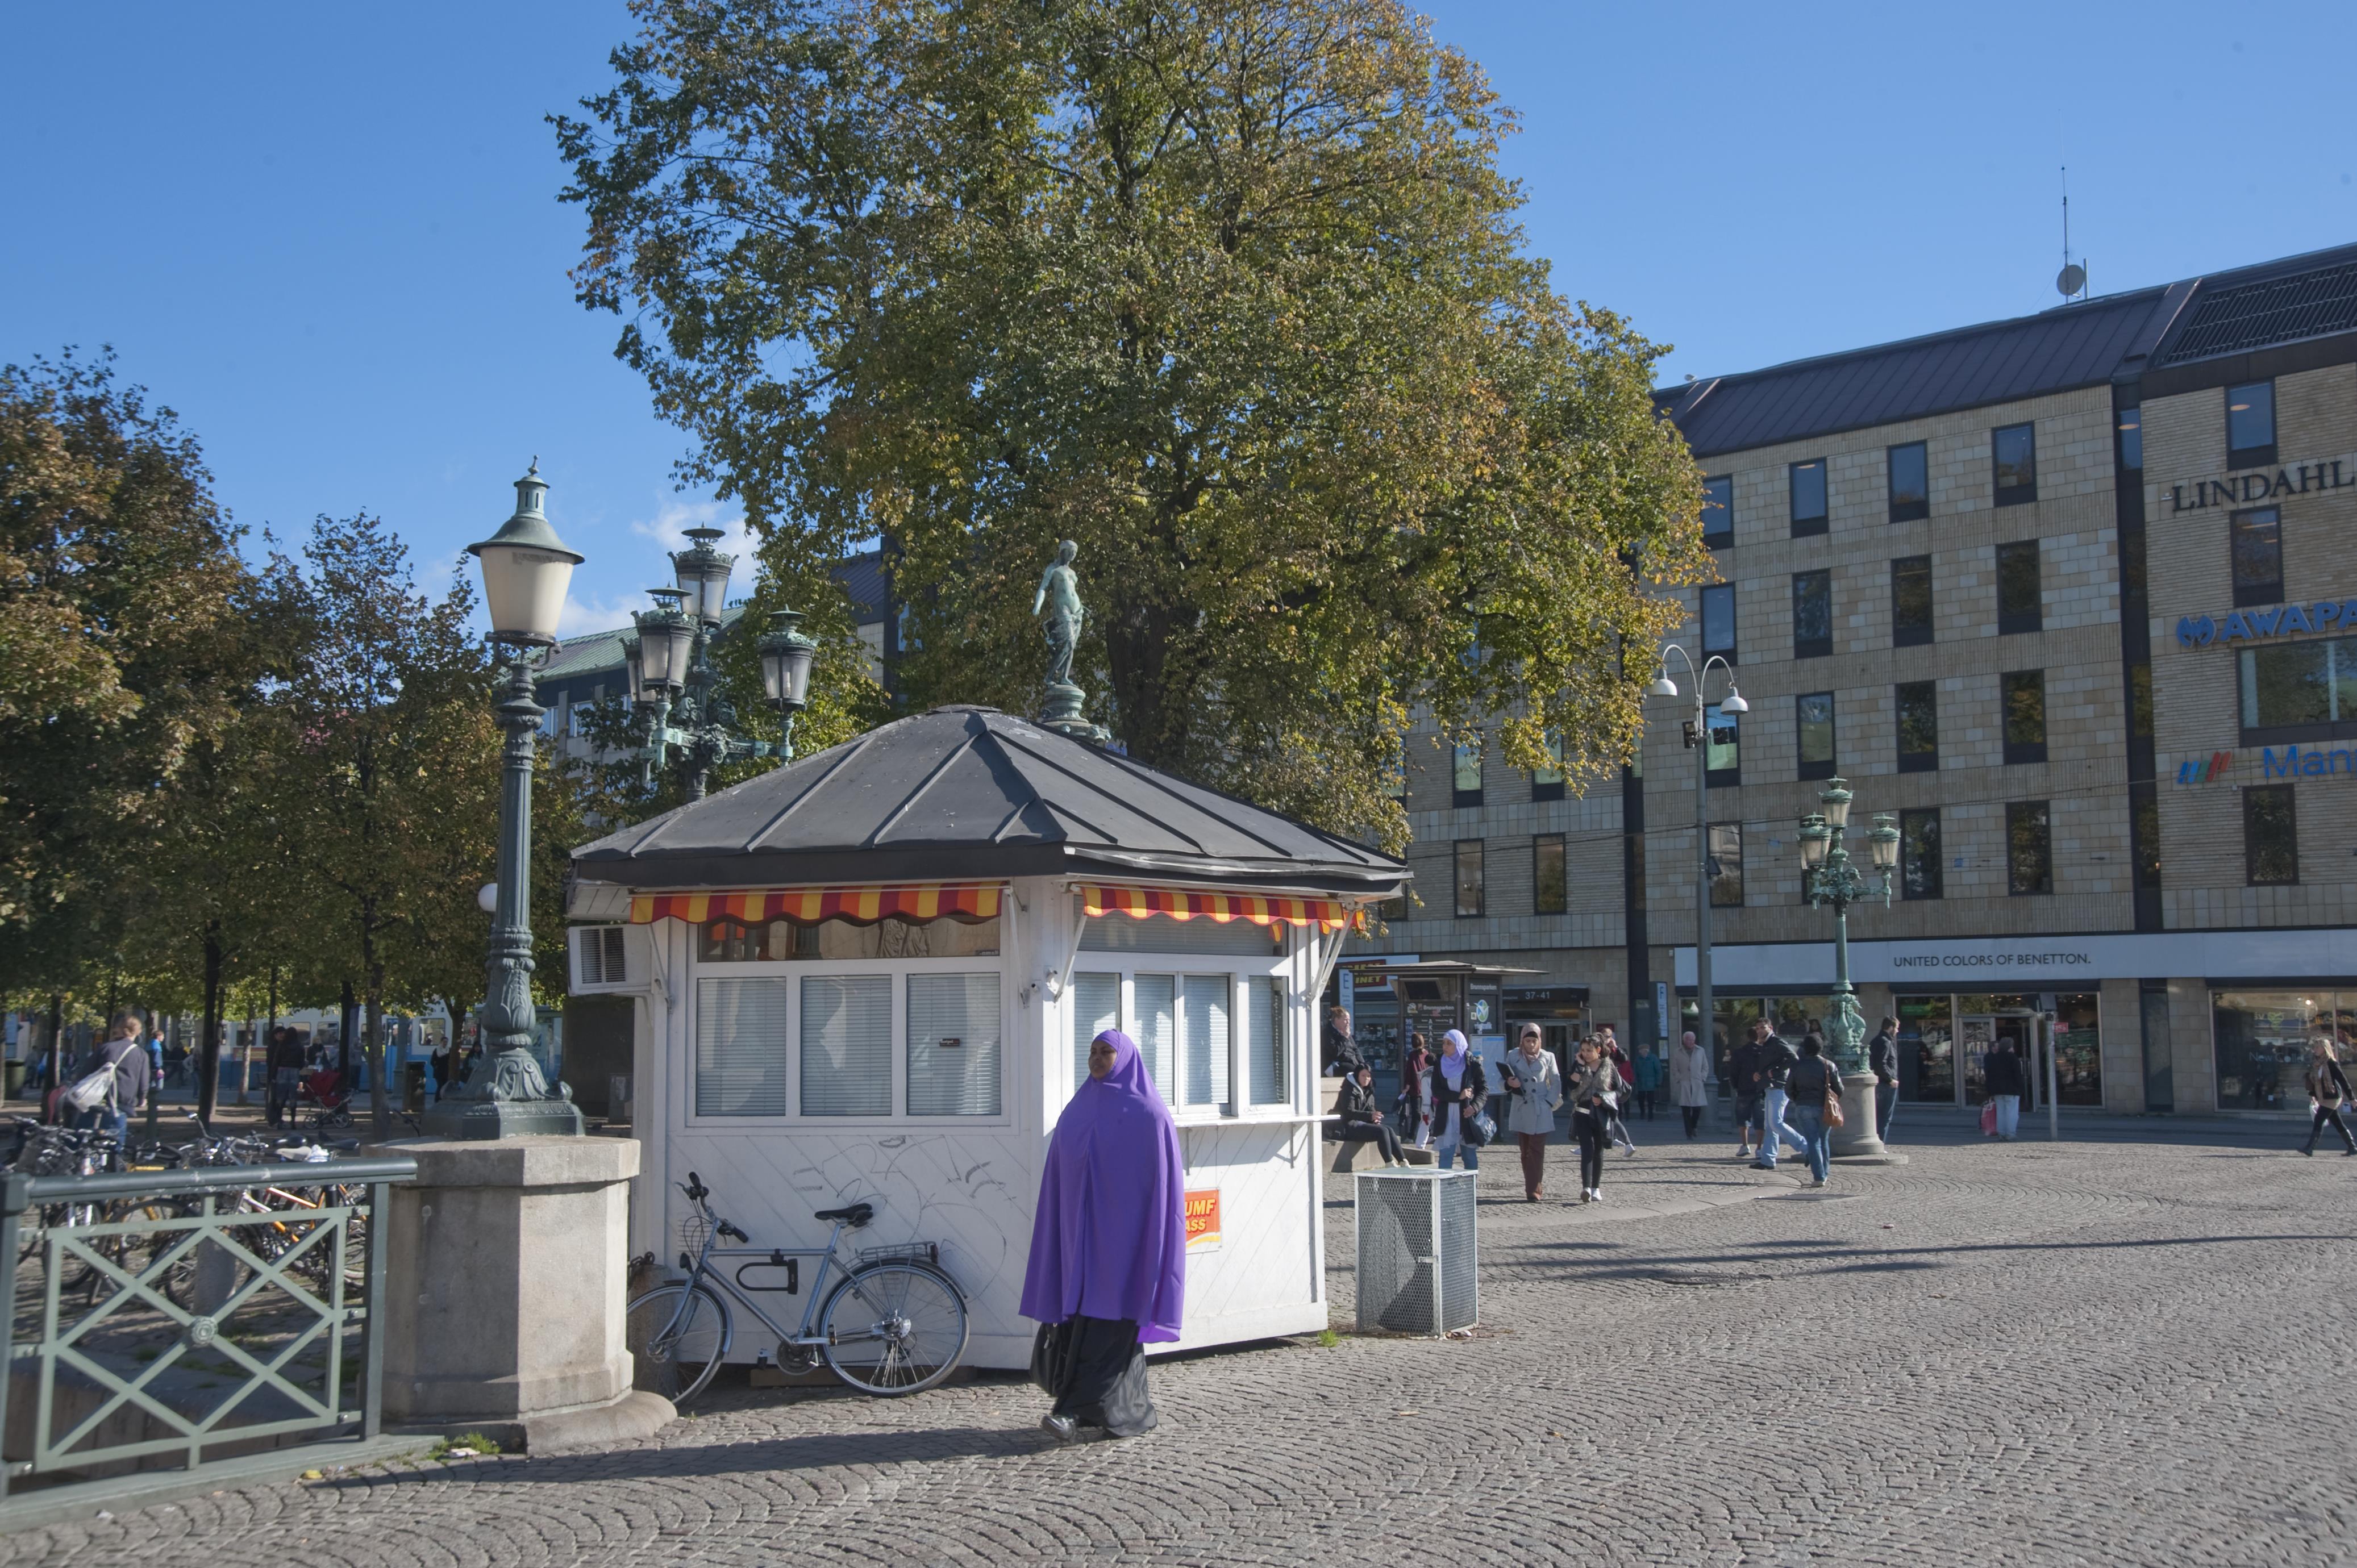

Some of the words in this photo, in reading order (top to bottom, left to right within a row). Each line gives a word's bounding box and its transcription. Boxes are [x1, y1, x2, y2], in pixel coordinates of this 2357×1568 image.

[2172, 460, 2355, 512] LINDAHL
[2263, 745, 2357, 779] Man
[1894, 956, 1940, 967] UNITED
[1943, 955, 1993, 966] COLORS
[1996, 954, 2014, 965] OF
[2017, 953, 2092, 965] BENETTON.
[1525, 991, 1550, 1000] 37-41
